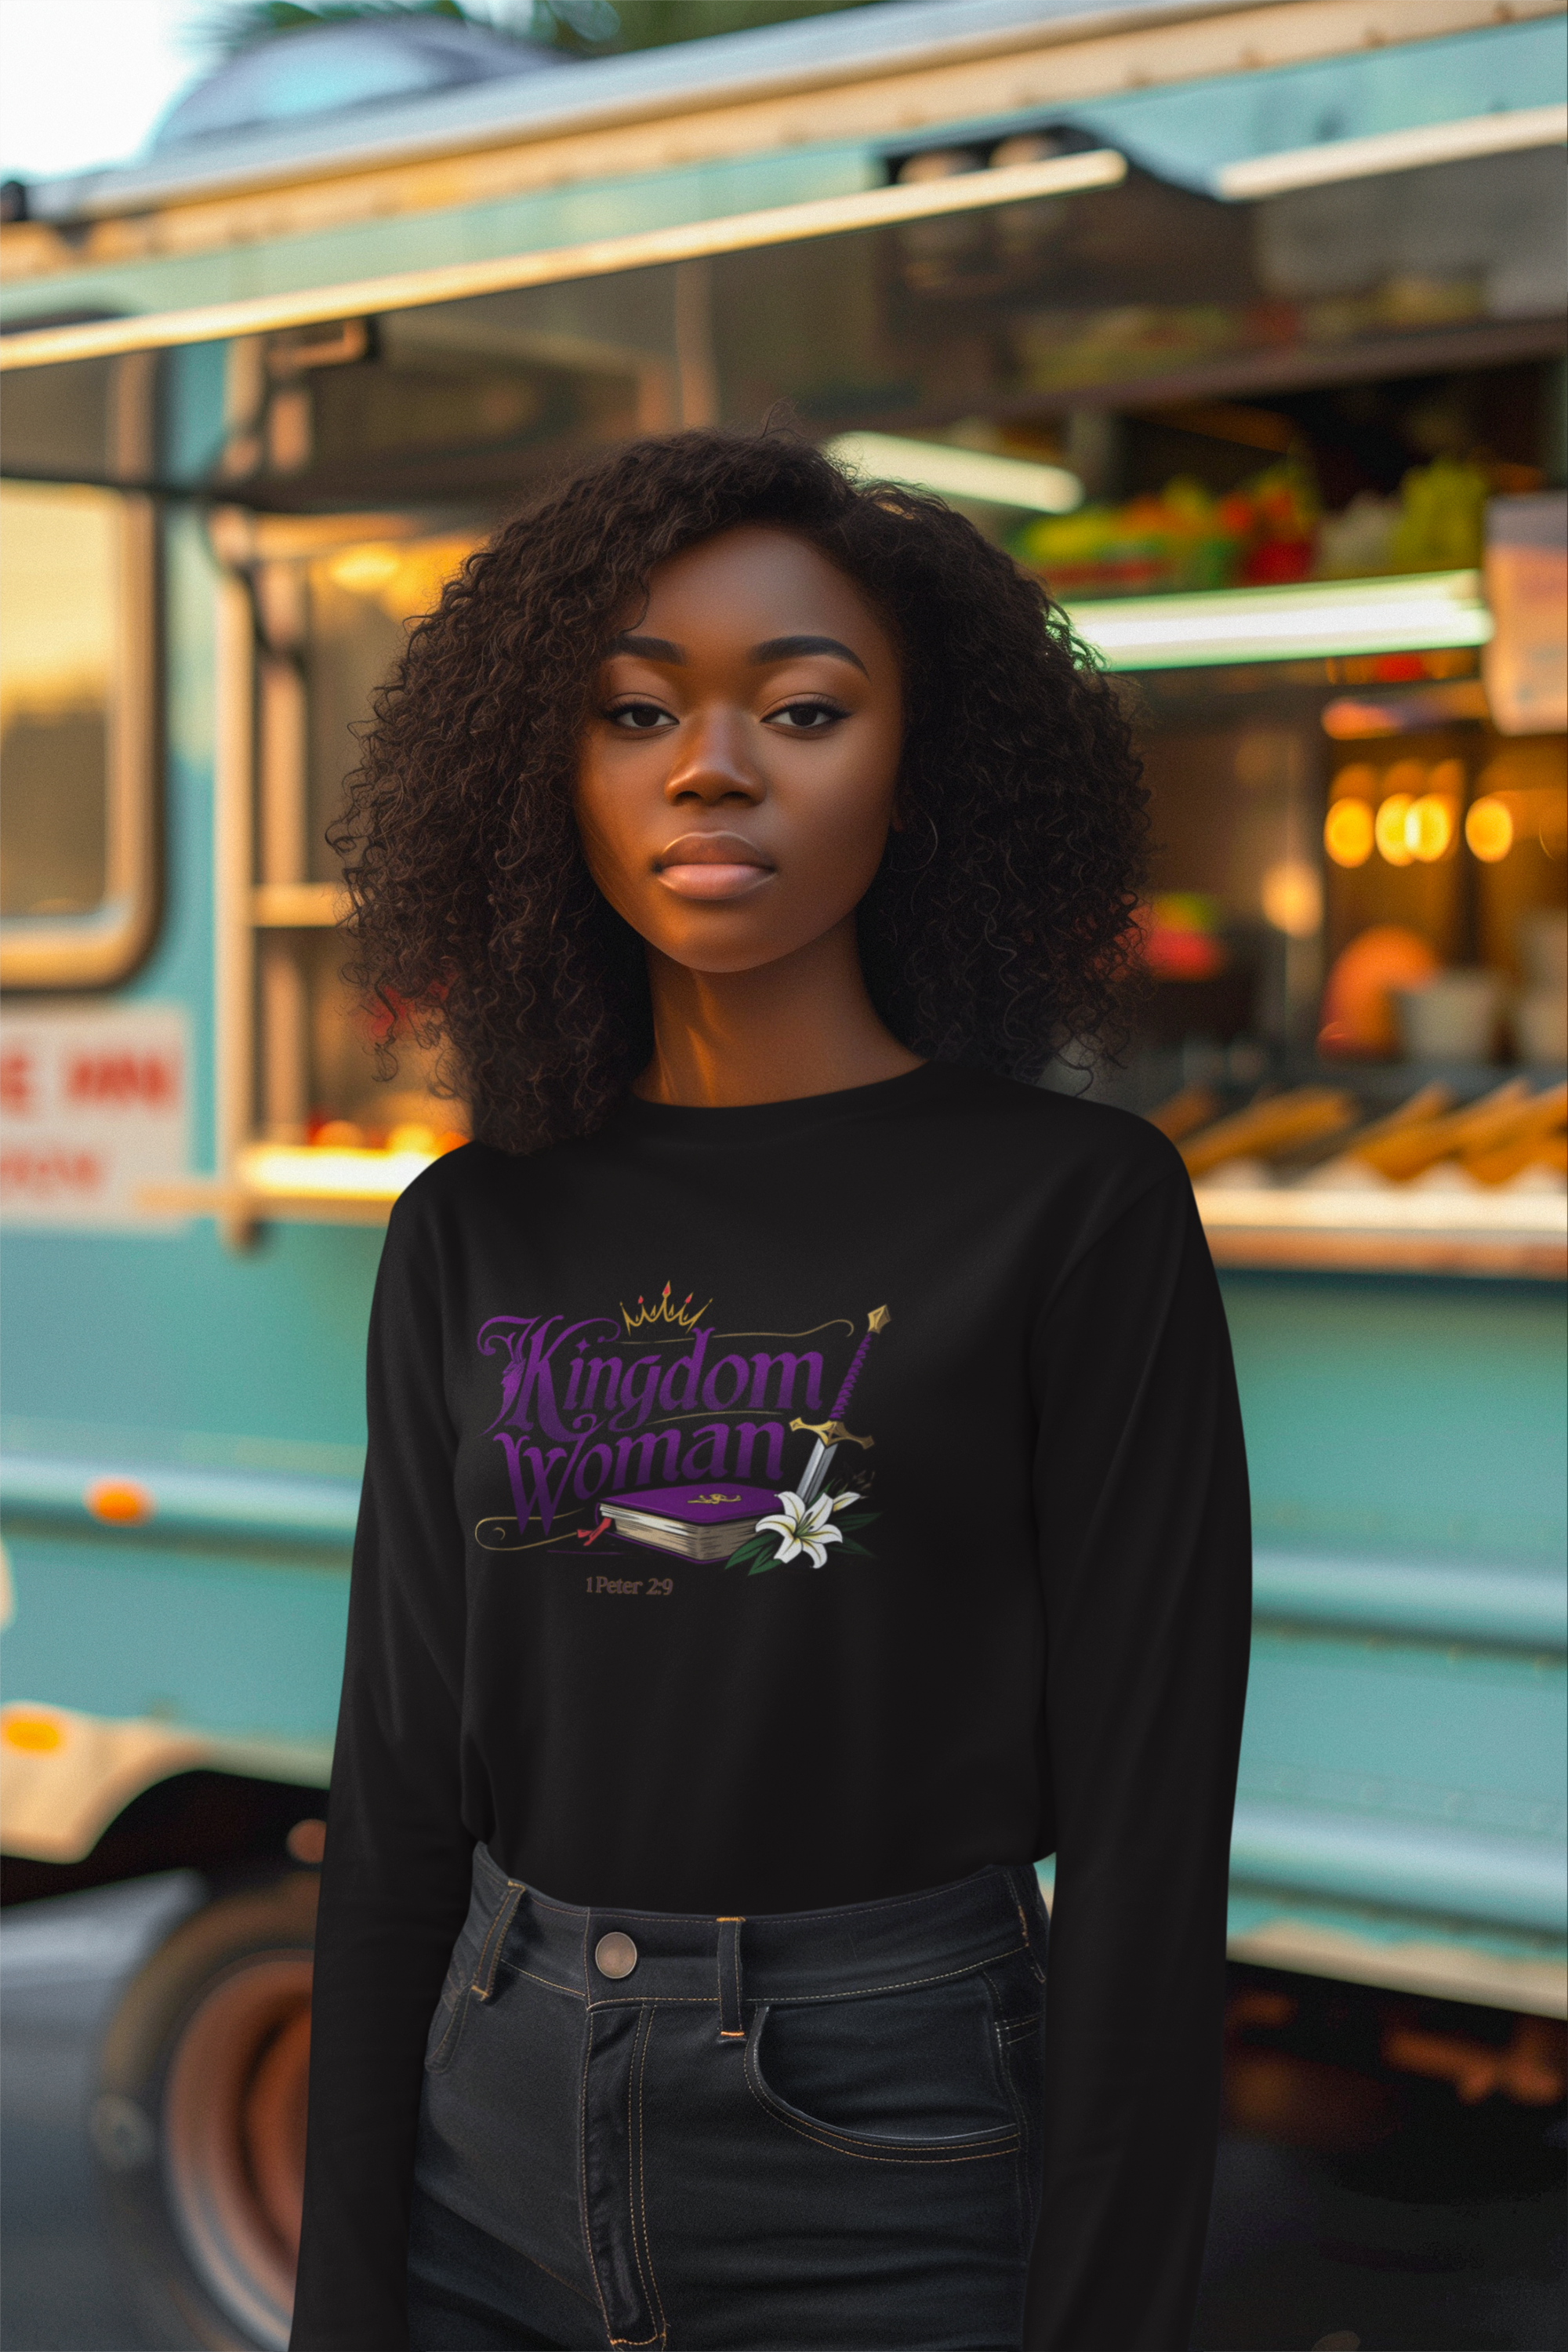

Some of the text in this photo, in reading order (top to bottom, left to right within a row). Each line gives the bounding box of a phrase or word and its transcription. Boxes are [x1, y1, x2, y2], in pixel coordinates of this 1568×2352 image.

[476, 1314, 825, 1442] Kingdom
[492, 1413, 785, 1536] Woman
[586, 1576, 673, 1595] 1 Peter 2:9
